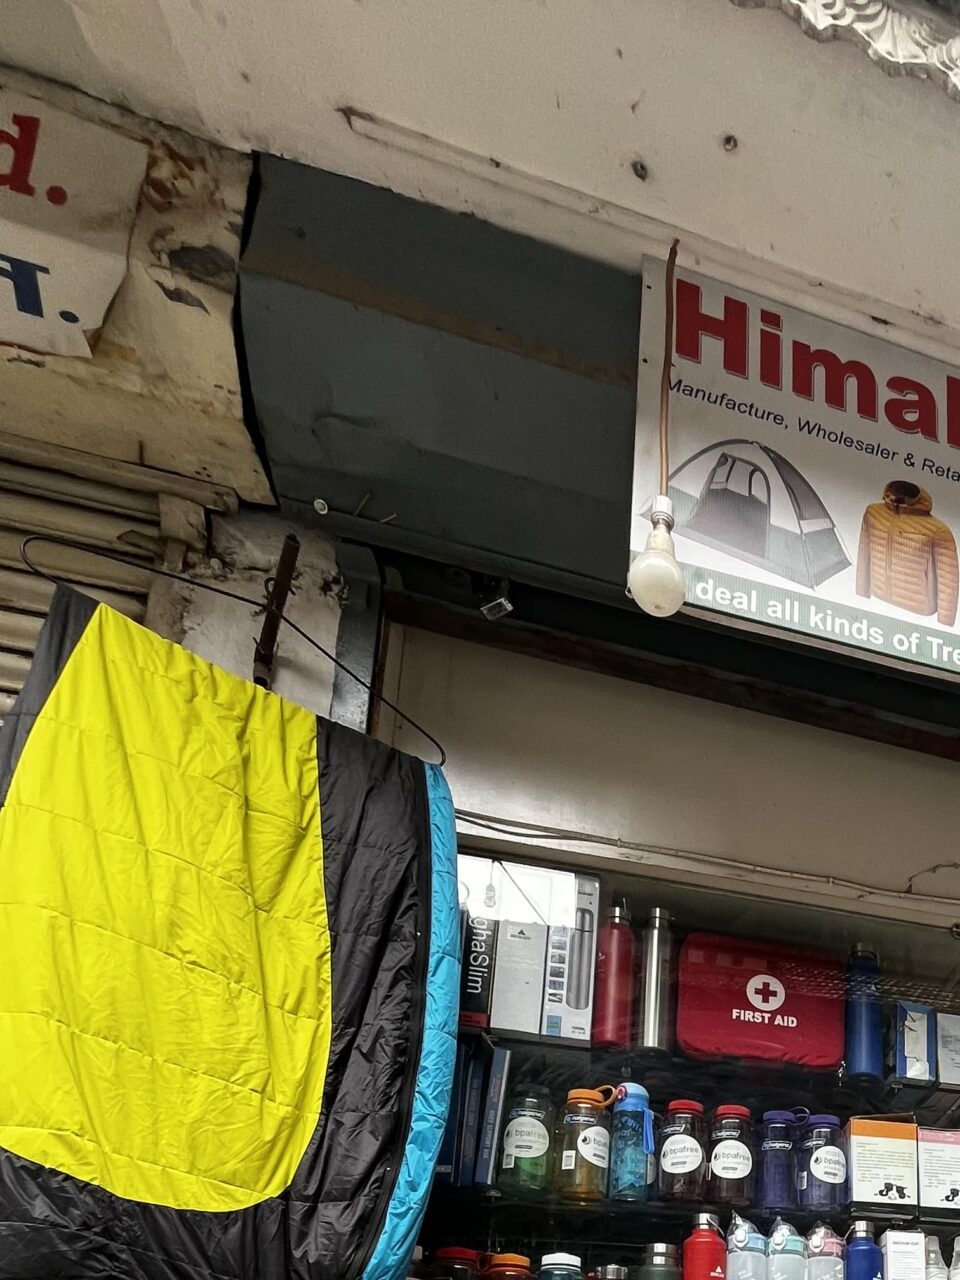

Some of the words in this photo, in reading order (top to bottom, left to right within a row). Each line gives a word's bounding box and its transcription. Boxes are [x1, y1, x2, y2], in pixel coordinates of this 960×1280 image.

[668, 378, 789, 430] Manufacture,
[797, 416, 899, 461] Wholesaler
[903, 453, 916, 468] &
[695, 579, 756, 612] deal
[766, 598, 799, 623] all
[810, 609, 884, 645] kinds
[893, 633, 920, 654] of
[732, 1009, 770, 1025] FIRST
[774, 1013, 797, 1028] AID
